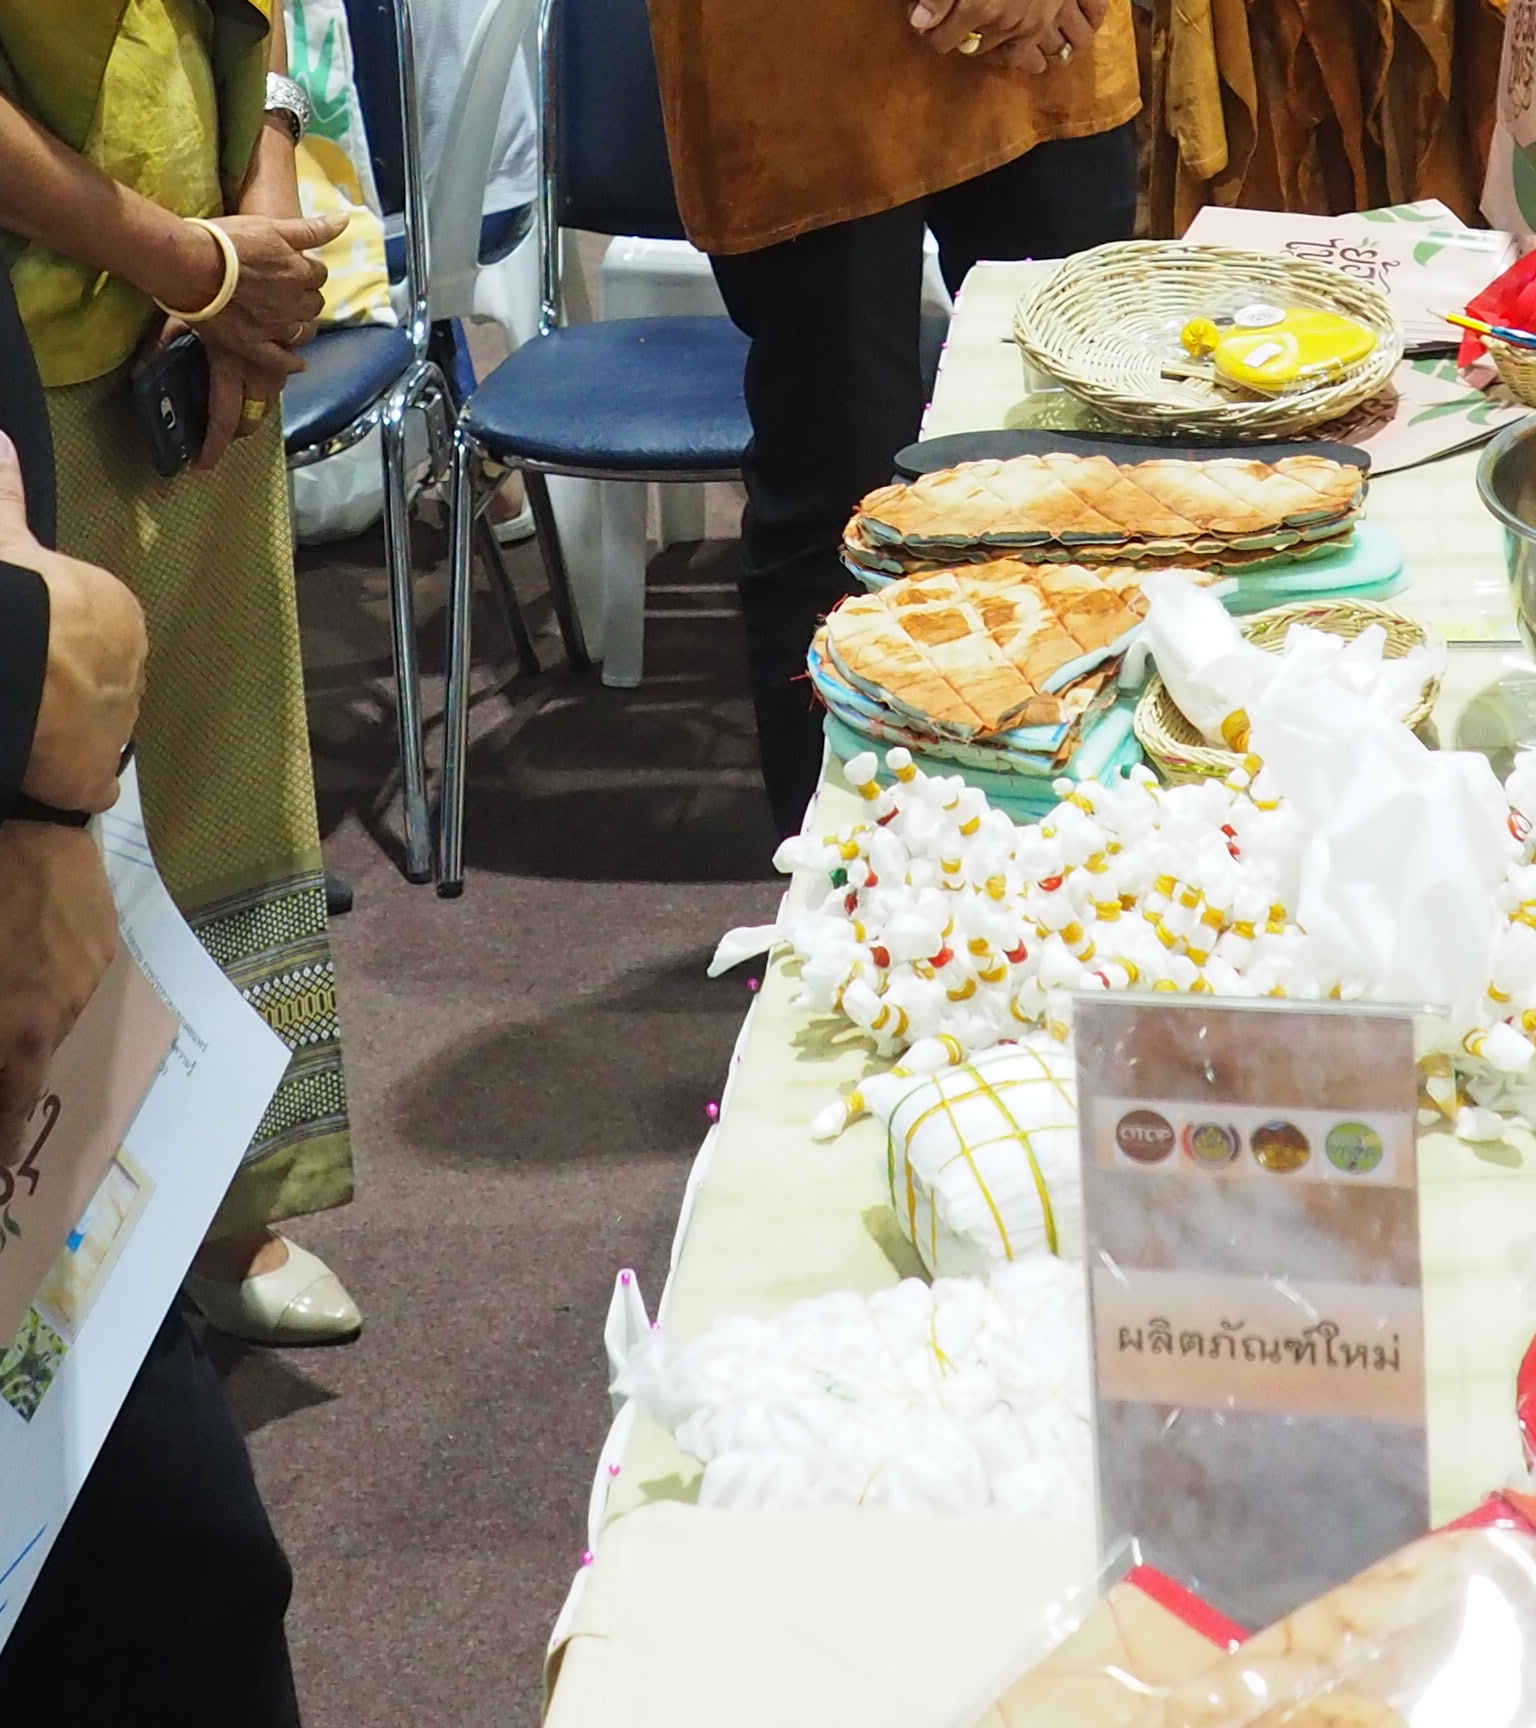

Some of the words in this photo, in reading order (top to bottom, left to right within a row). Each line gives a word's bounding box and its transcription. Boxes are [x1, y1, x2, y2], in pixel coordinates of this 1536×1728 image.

[1119, 1126, 1171, 1142] OTOP
[1118, 1317, 1401, 1371] ผลิตภัณฑ์ใหม่
